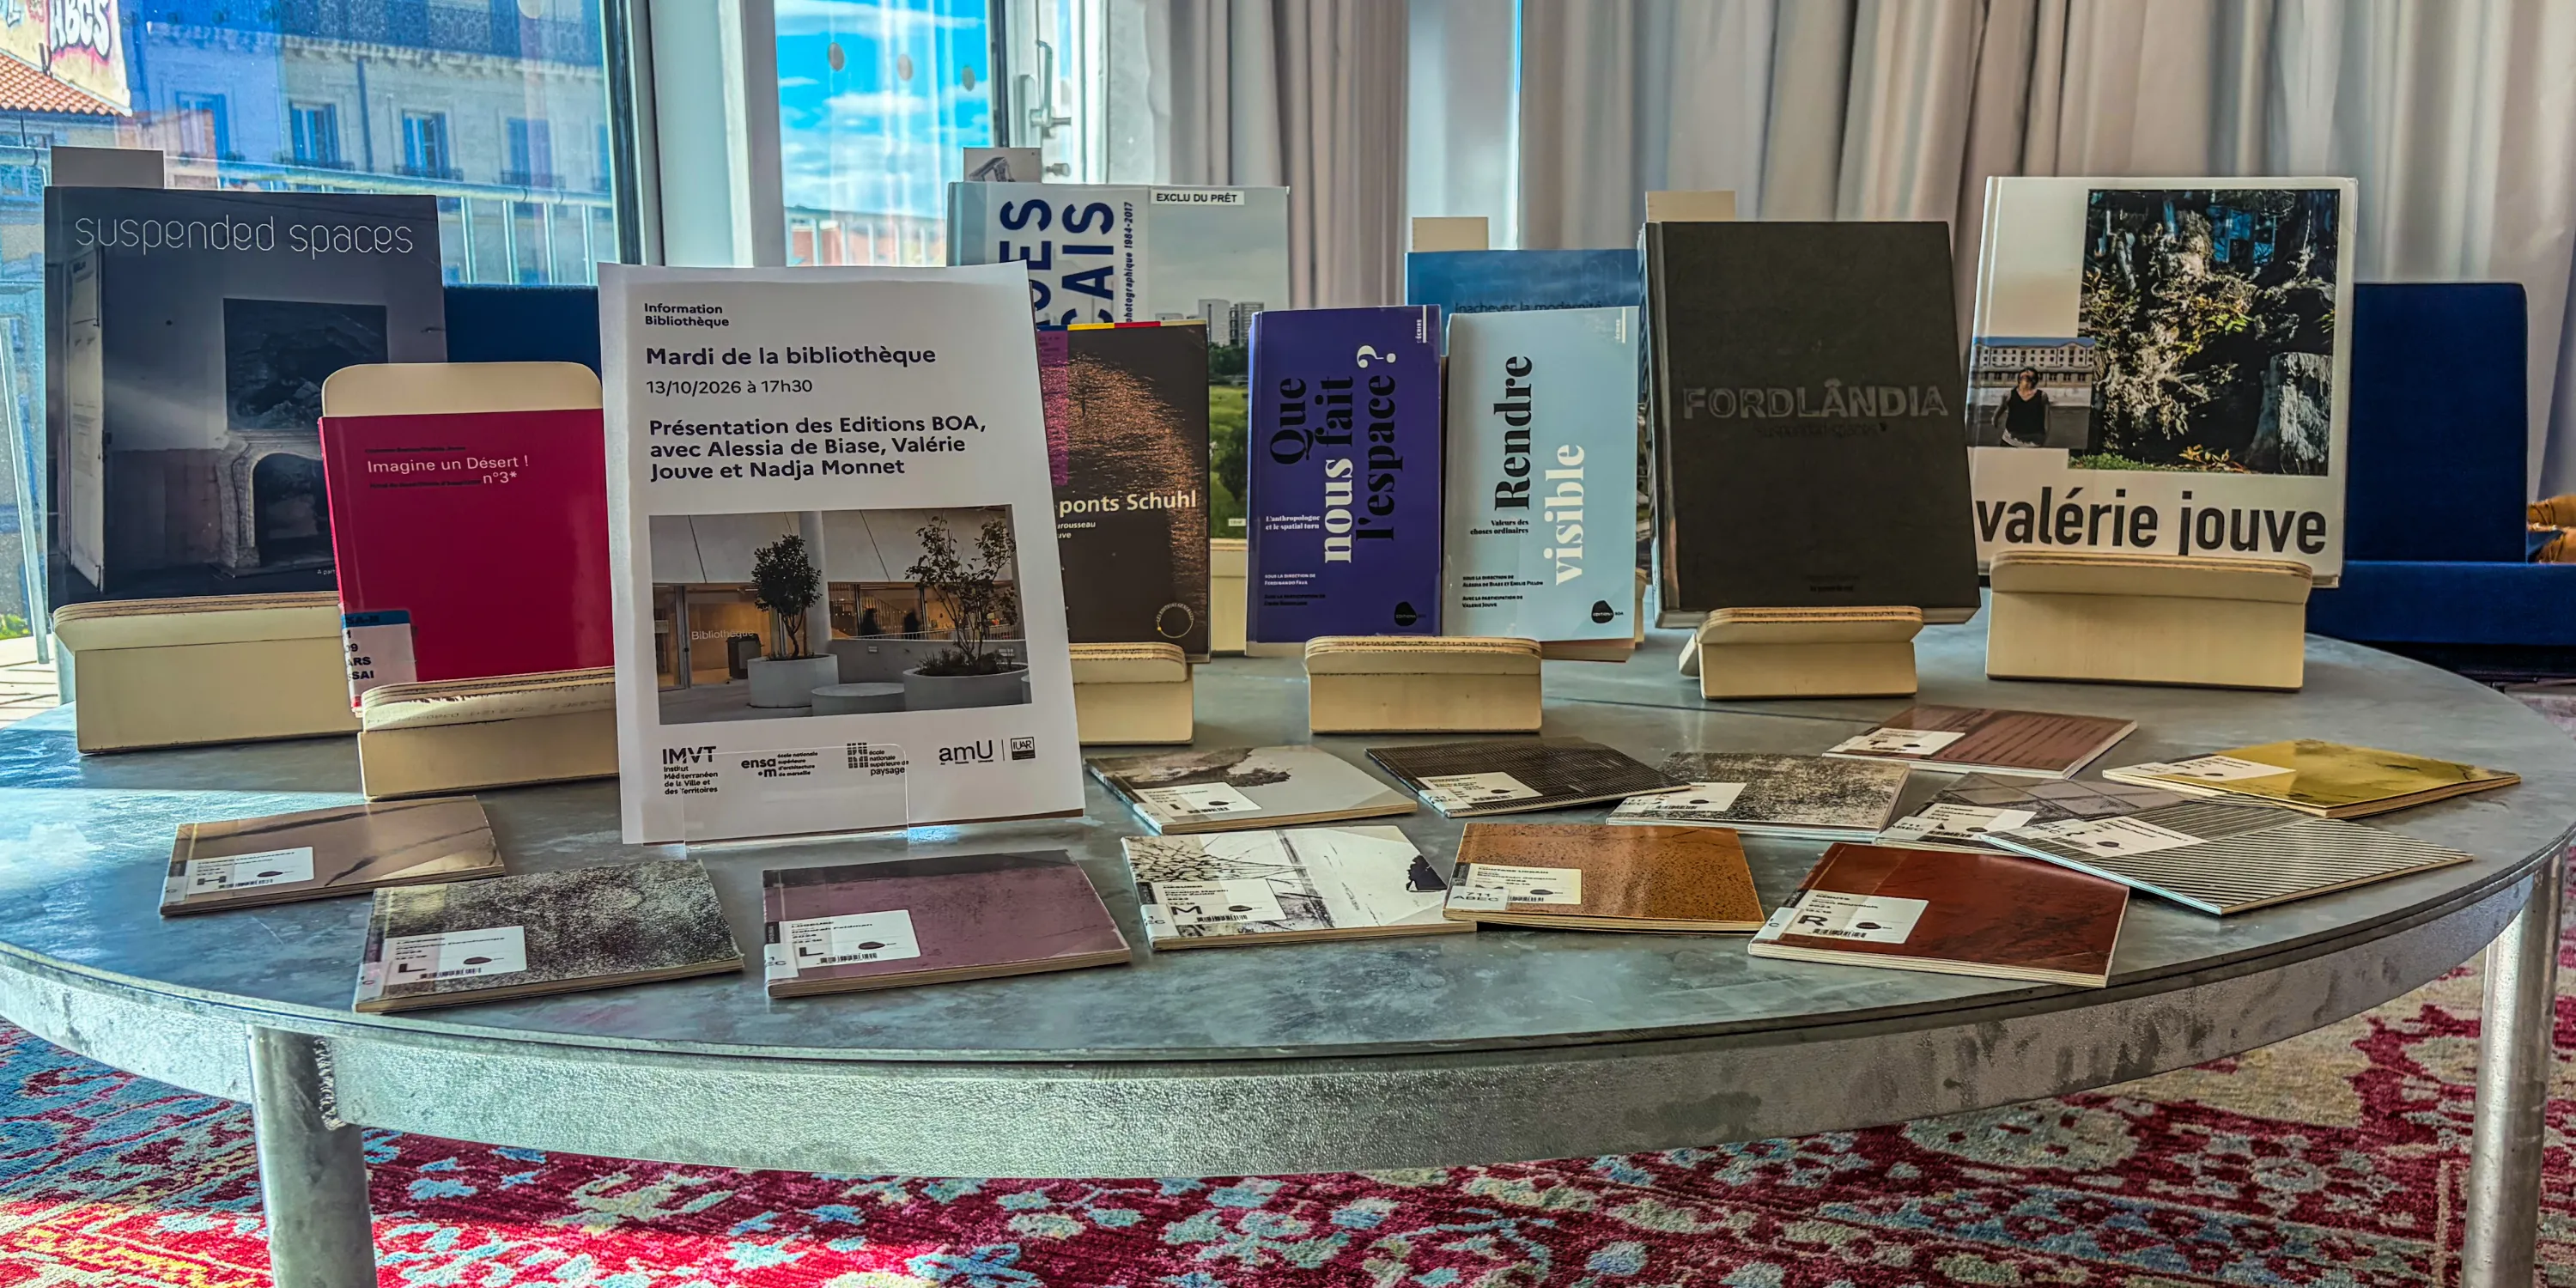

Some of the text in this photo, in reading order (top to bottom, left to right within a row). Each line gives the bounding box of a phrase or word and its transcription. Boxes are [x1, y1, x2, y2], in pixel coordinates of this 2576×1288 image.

[1156, 191, 1238, 204] EXCLU DU PRÊT
[1124, 202, 1133, 249] 1984-2017
[75, 214, 414, 260] suspended spaces
[644, 303, 723, 315] Information
[645, 315, 730, 329] Bibliothèque
[646, 346, 937, 368] Mardi de la bibliothèque
[646, 380, 813, 397] 13/10/2026 à 17h30
[649, 416, 987, 436] Présentation des Editions BOA,
[1269, 377, 1315, 465] Que
[1355, 345, 1404, 541] l'espace ?
[1493, 355, 1533, 511] Rendre
[650, 436, 966, 458] avec Alessia de Biase, Valérie
[367, 454, 529, 475] Imagine un Désert !
[650, 459, 905, 483] Jouve et Nadja Monnet
[1314, 375, 1354, 563] nous fait
[1059, 489, 1197, 518] ponts Schuhl
[1543, 444, 1586, 586] visible
[1976, 486, 2326, 556] valérie jouve
[662, 746, 717, 764] IMVT
[741, 758, 777, 769] ensa
[871, 767, 906, 776] paysage
[1170, 906, 1203, 915] M
[1797, 914, 1828, 927] R
[799, 947, 824, 957] L
[398, 963, 428, 973] L
